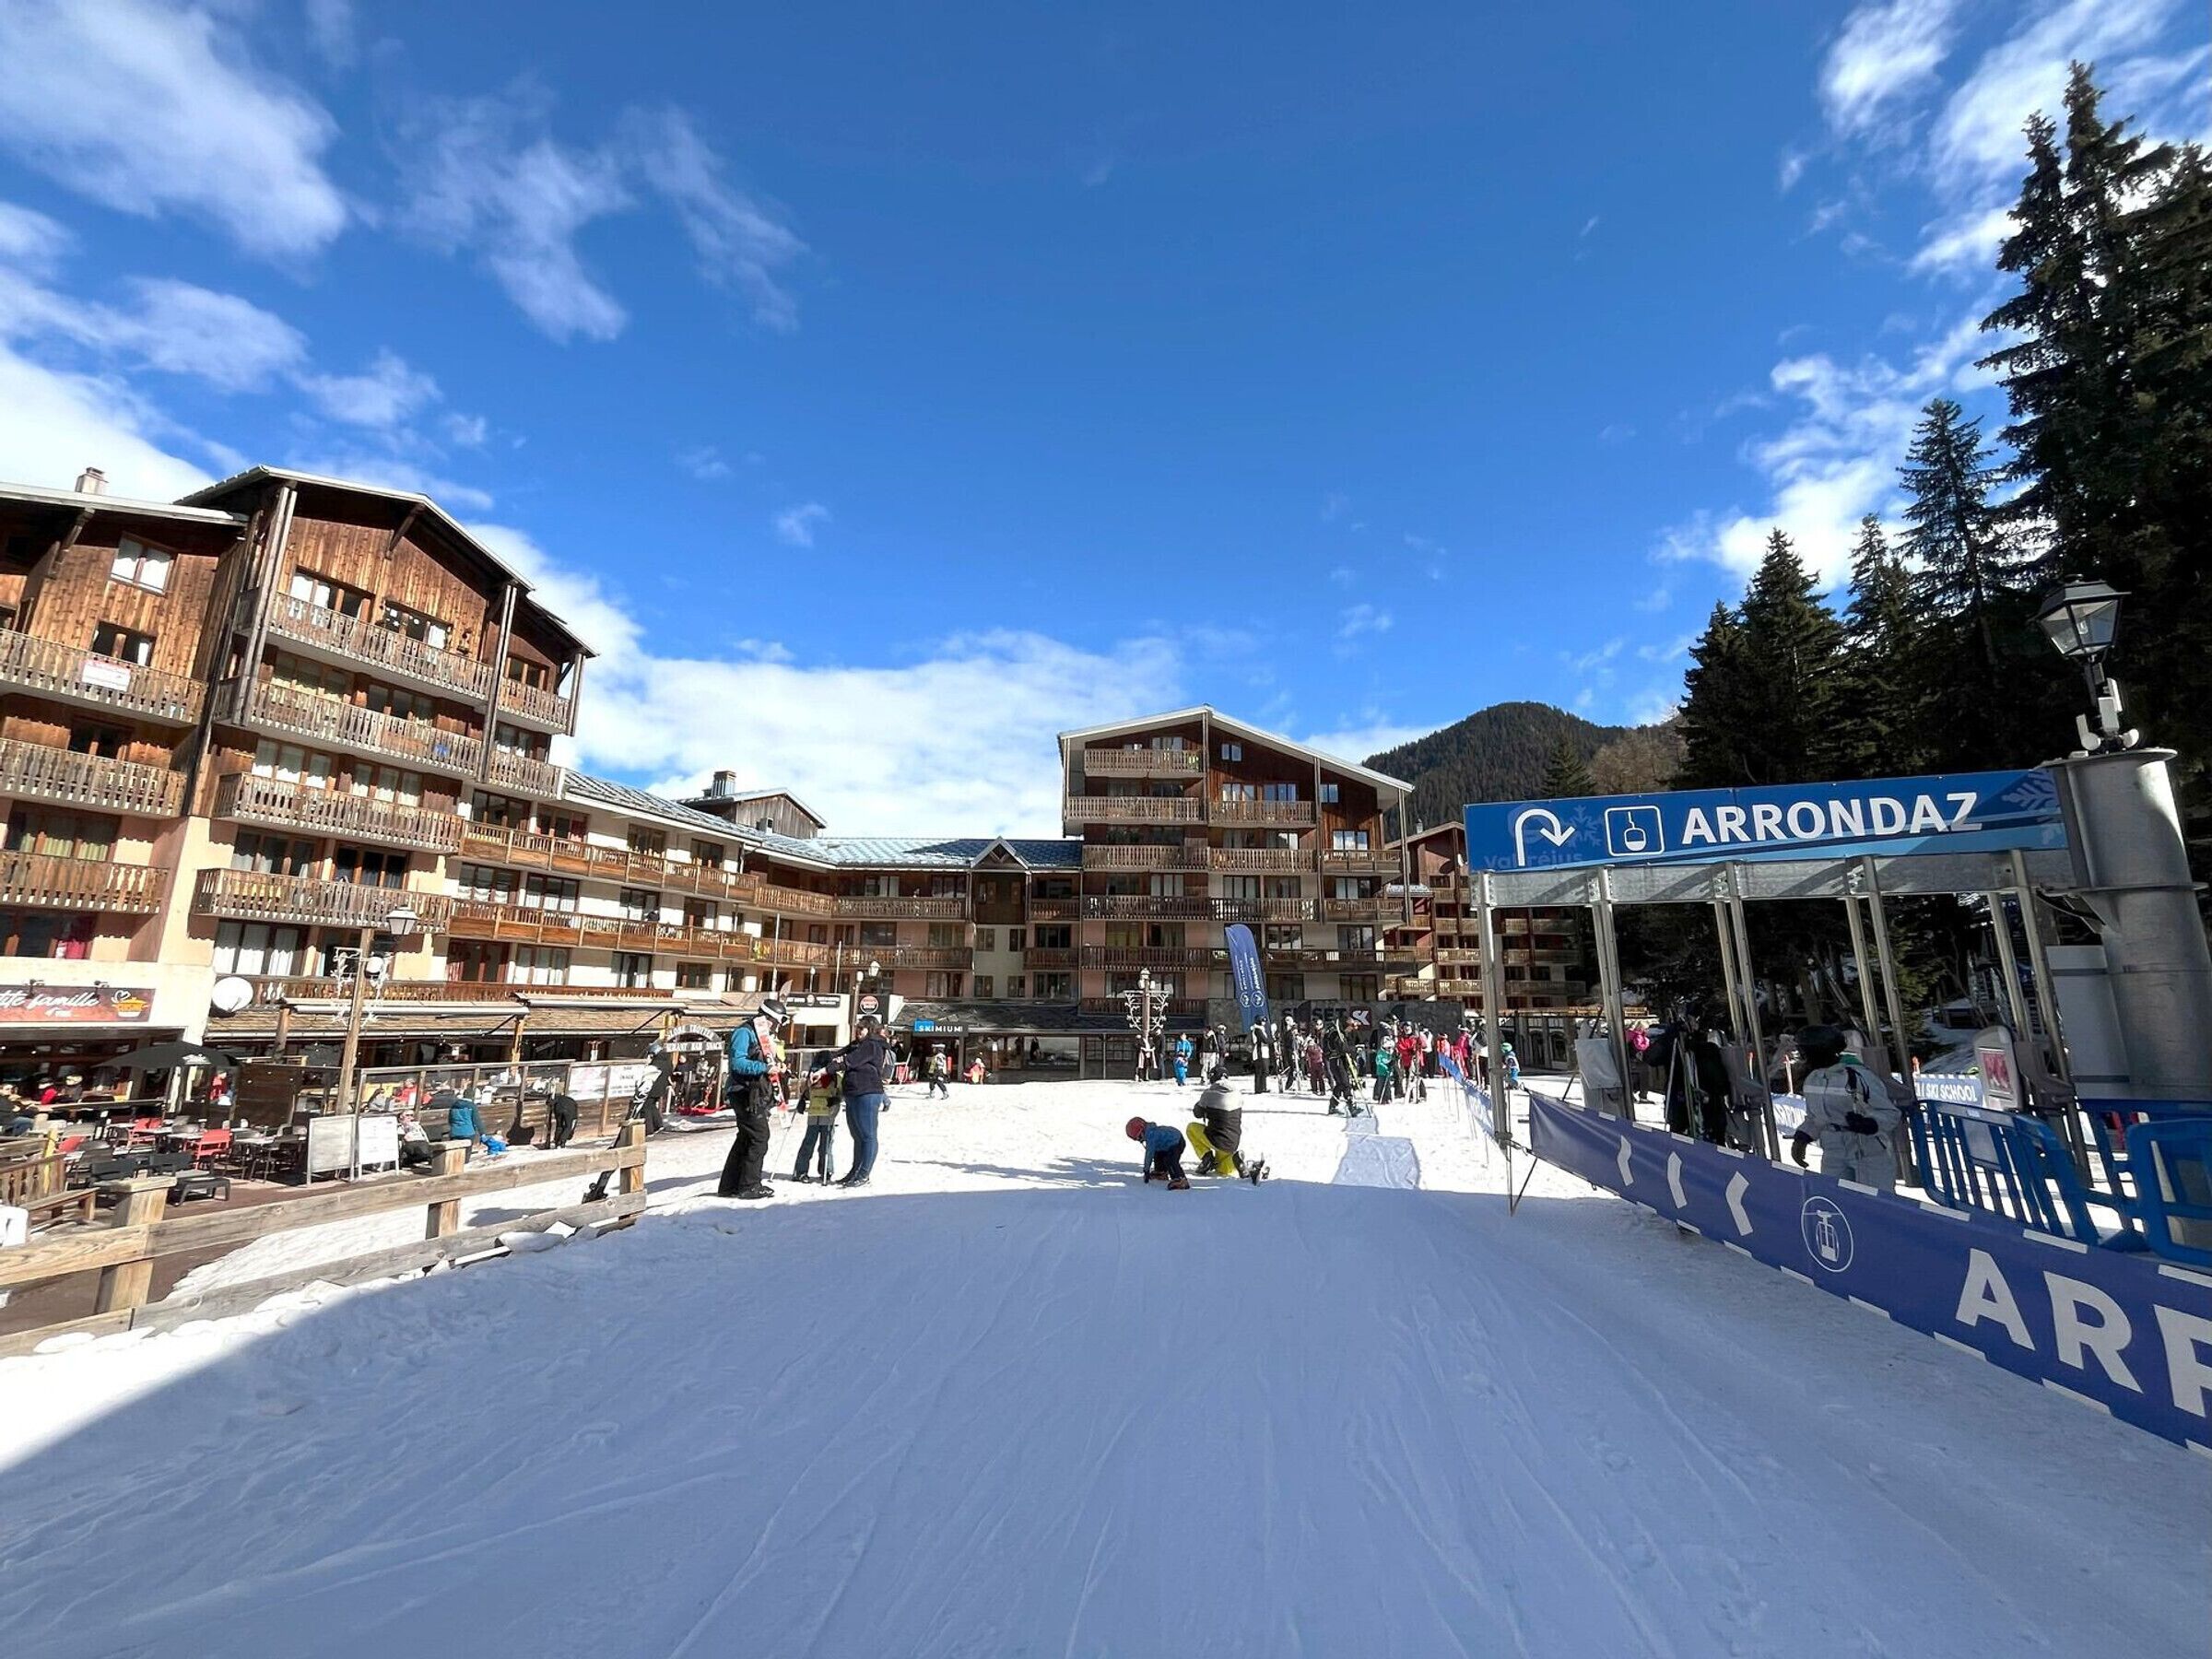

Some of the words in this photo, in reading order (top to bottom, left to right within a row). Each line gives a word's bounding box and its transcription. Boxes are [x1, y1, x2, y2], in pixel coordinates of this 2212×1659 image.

[1681, 792, 1983, 845] ARRONDAZ
[26, 992, 100, 1010] famille
[1940, 1084, 1978, 1102] SCHOOL
